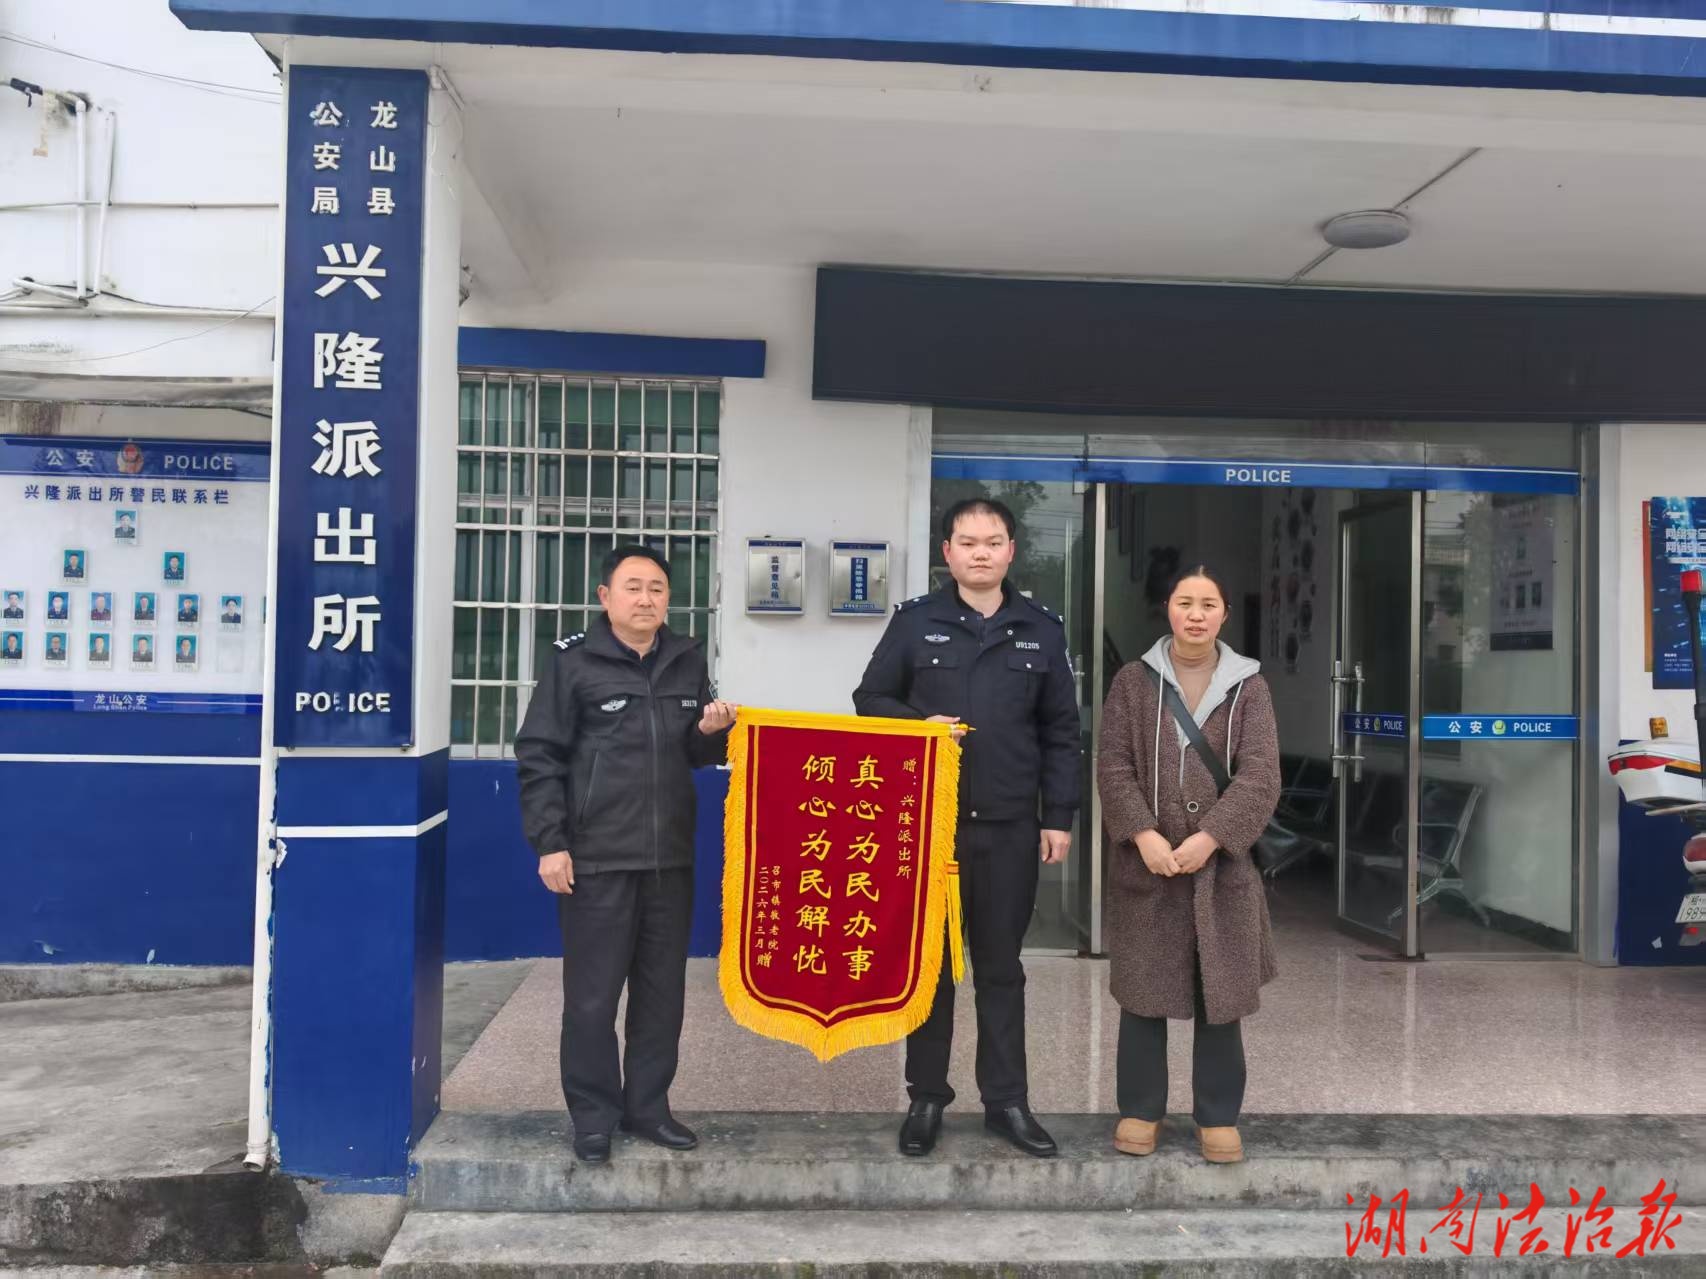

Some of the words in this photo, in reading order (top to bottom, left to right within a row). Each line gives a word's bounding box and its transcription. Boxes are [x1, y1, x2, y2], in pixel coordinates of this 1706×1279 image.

[311, 101, 343, 214] 公安局
[367, 101, 398, 215] 龙山县
[308, 242, 387, 652] 兴隆派出所
[46, 449, 94, 468] 公安
[164, 455, 233, 471] POLICE
[1225, 469, 1291, 483] POLICE
[24, 485, 229, 504] 兴隆派出所警民联系栏
[95, 693, 148, 706] 龙山公安
[1383, 720, 1402, 731] POLICE
[1448, 720, 1483, 734] 公安
[1514, 722, 1551, 732] POLICE
[792, 754, 837, 975] 倾心为民解忧
[841, 754, 884, 981] 真心为民办事
